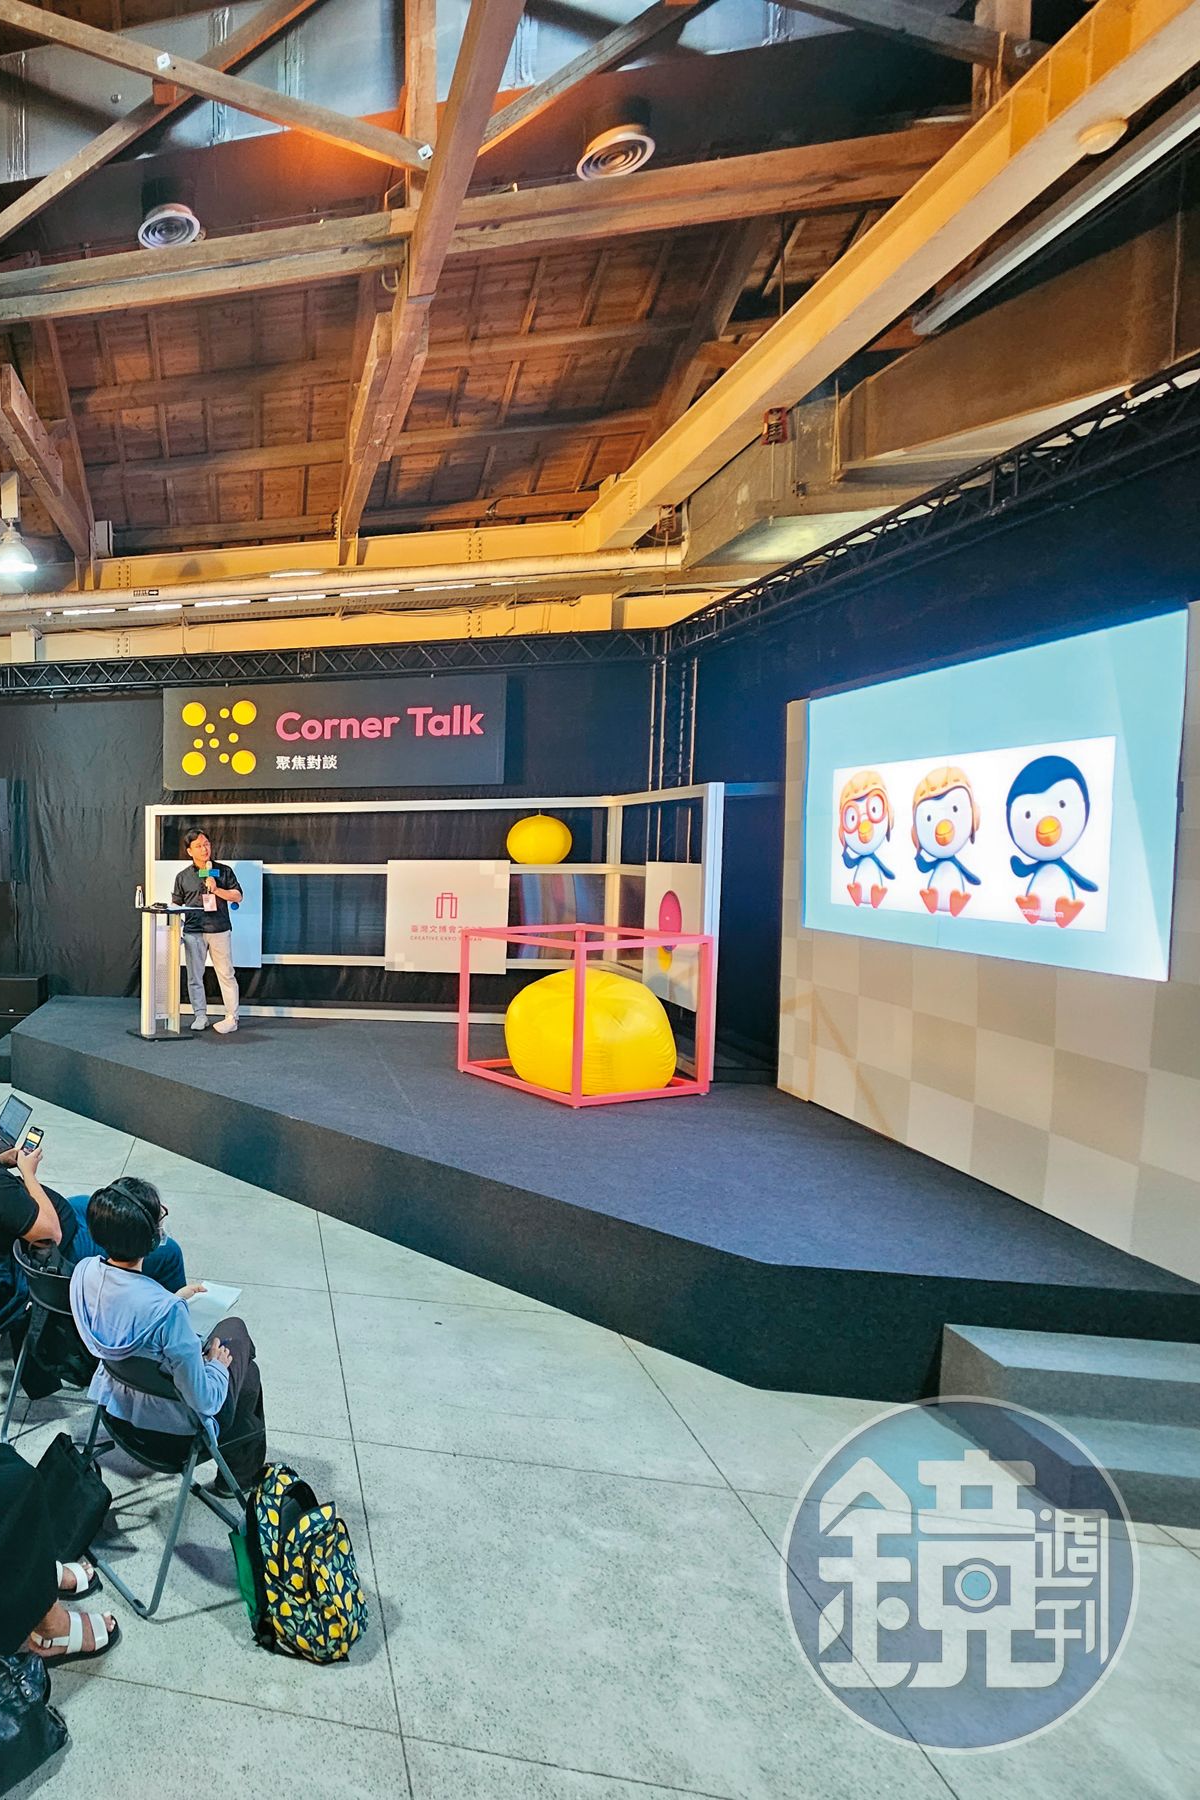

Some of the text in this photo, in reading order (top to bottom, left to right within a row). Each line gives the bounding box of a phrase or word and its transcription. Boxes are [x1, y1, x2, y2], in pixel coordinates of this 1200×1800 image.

[275, 704, 485, 741] Corner Talk
[275, 754, 338, 770] 聚焦對談
